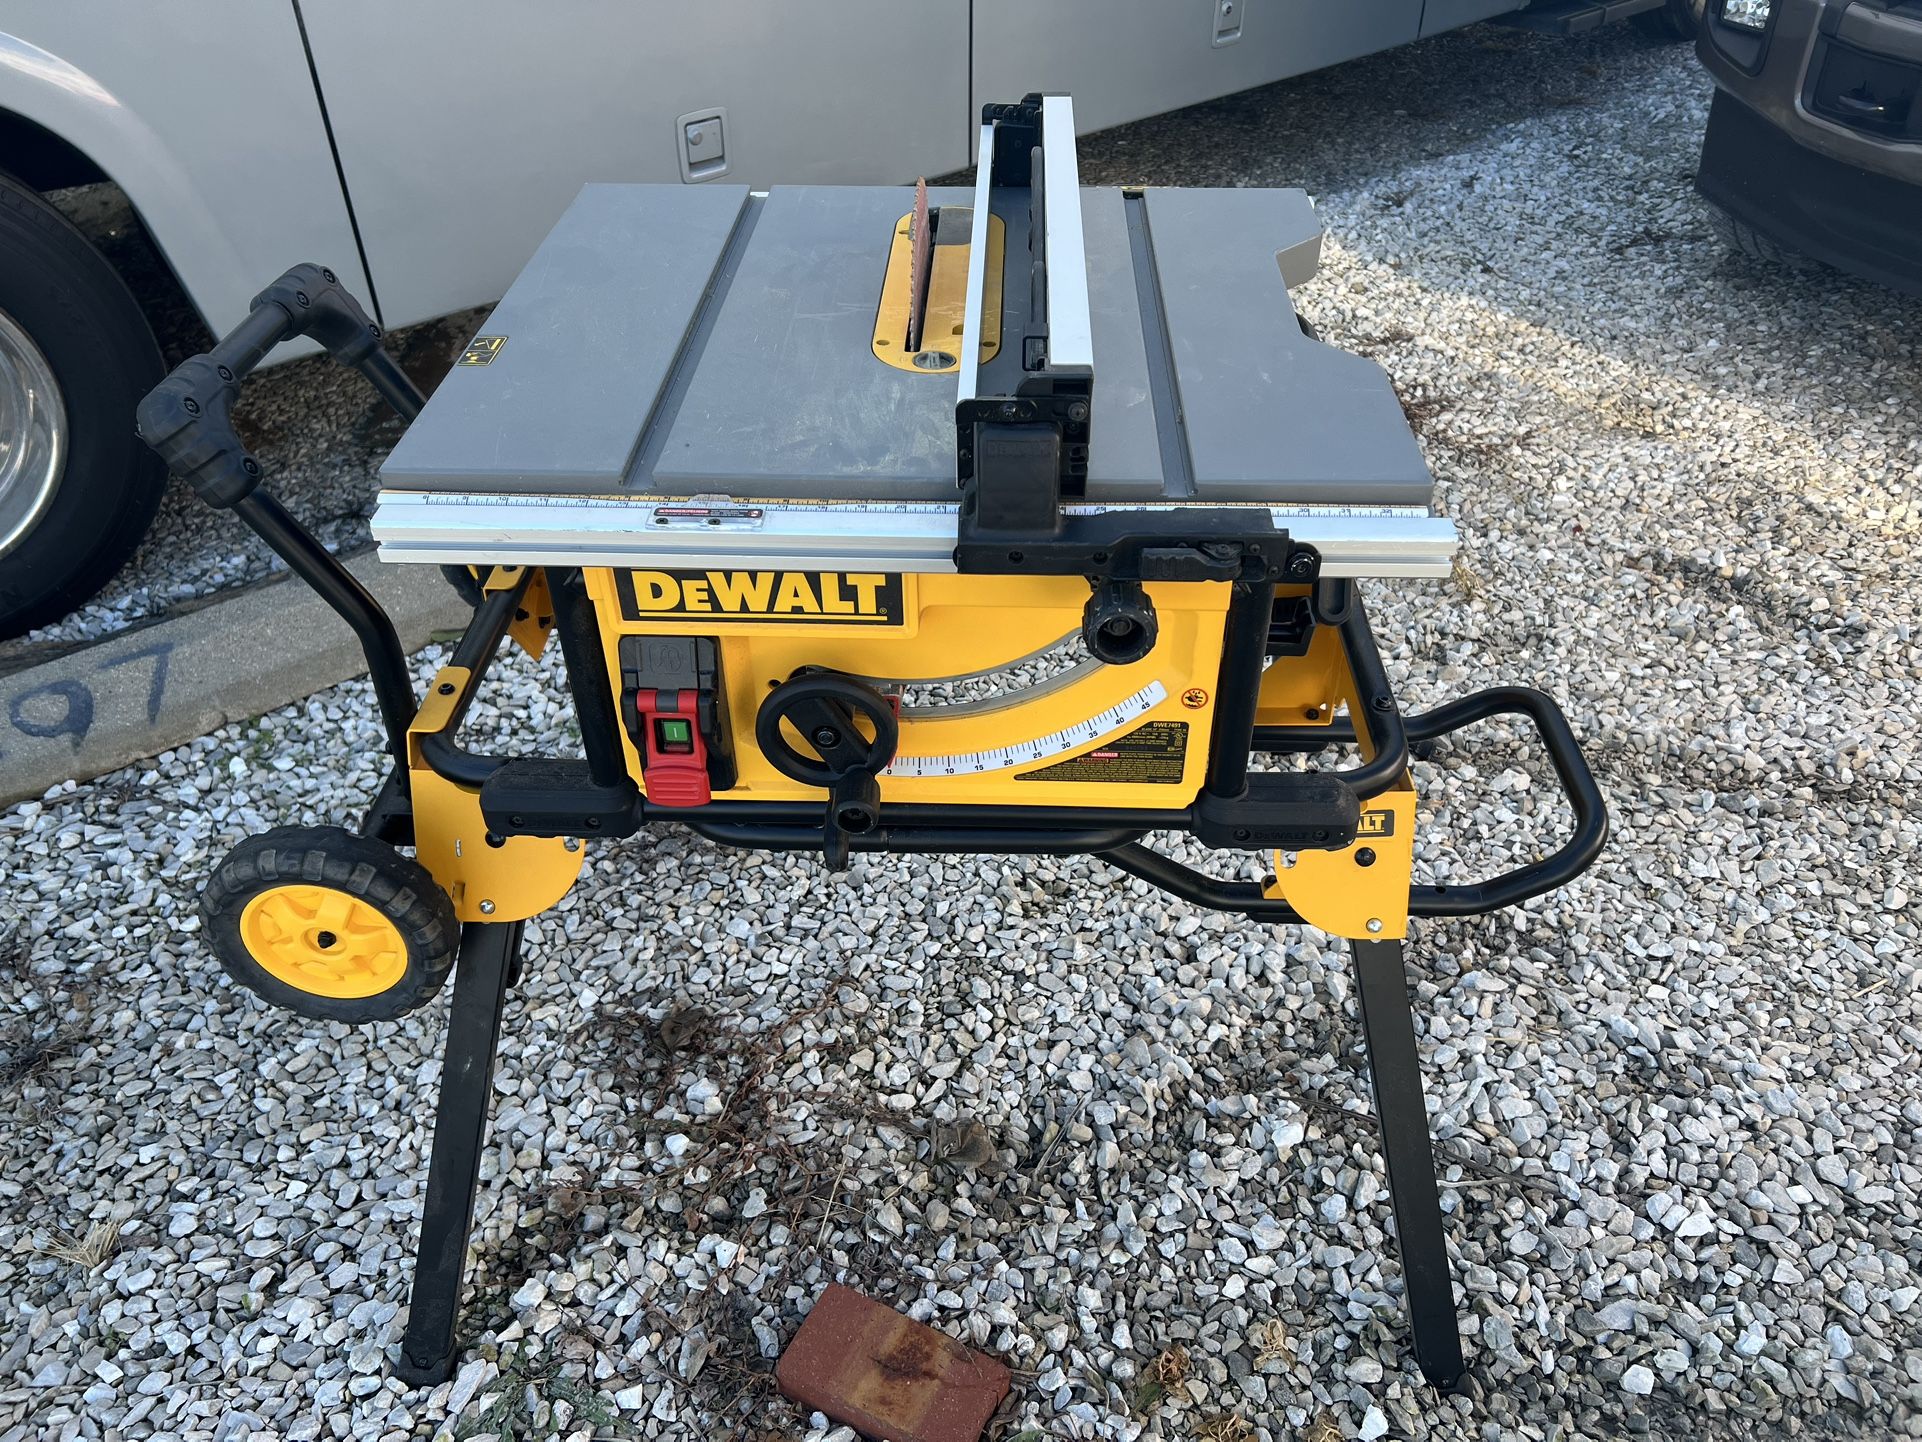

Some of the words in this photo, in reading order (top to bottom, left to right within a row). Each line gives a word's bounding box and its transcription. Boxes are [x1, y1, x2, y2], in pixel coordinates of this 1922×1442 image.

[1033, 751, 1043, 759] 25
[1061, 742, 1071, 750] 30
[1088, 730, 1098, 739] 35
[1115, 717, 1125, 725] 40
[1141, 701, 1151, 710] 45
